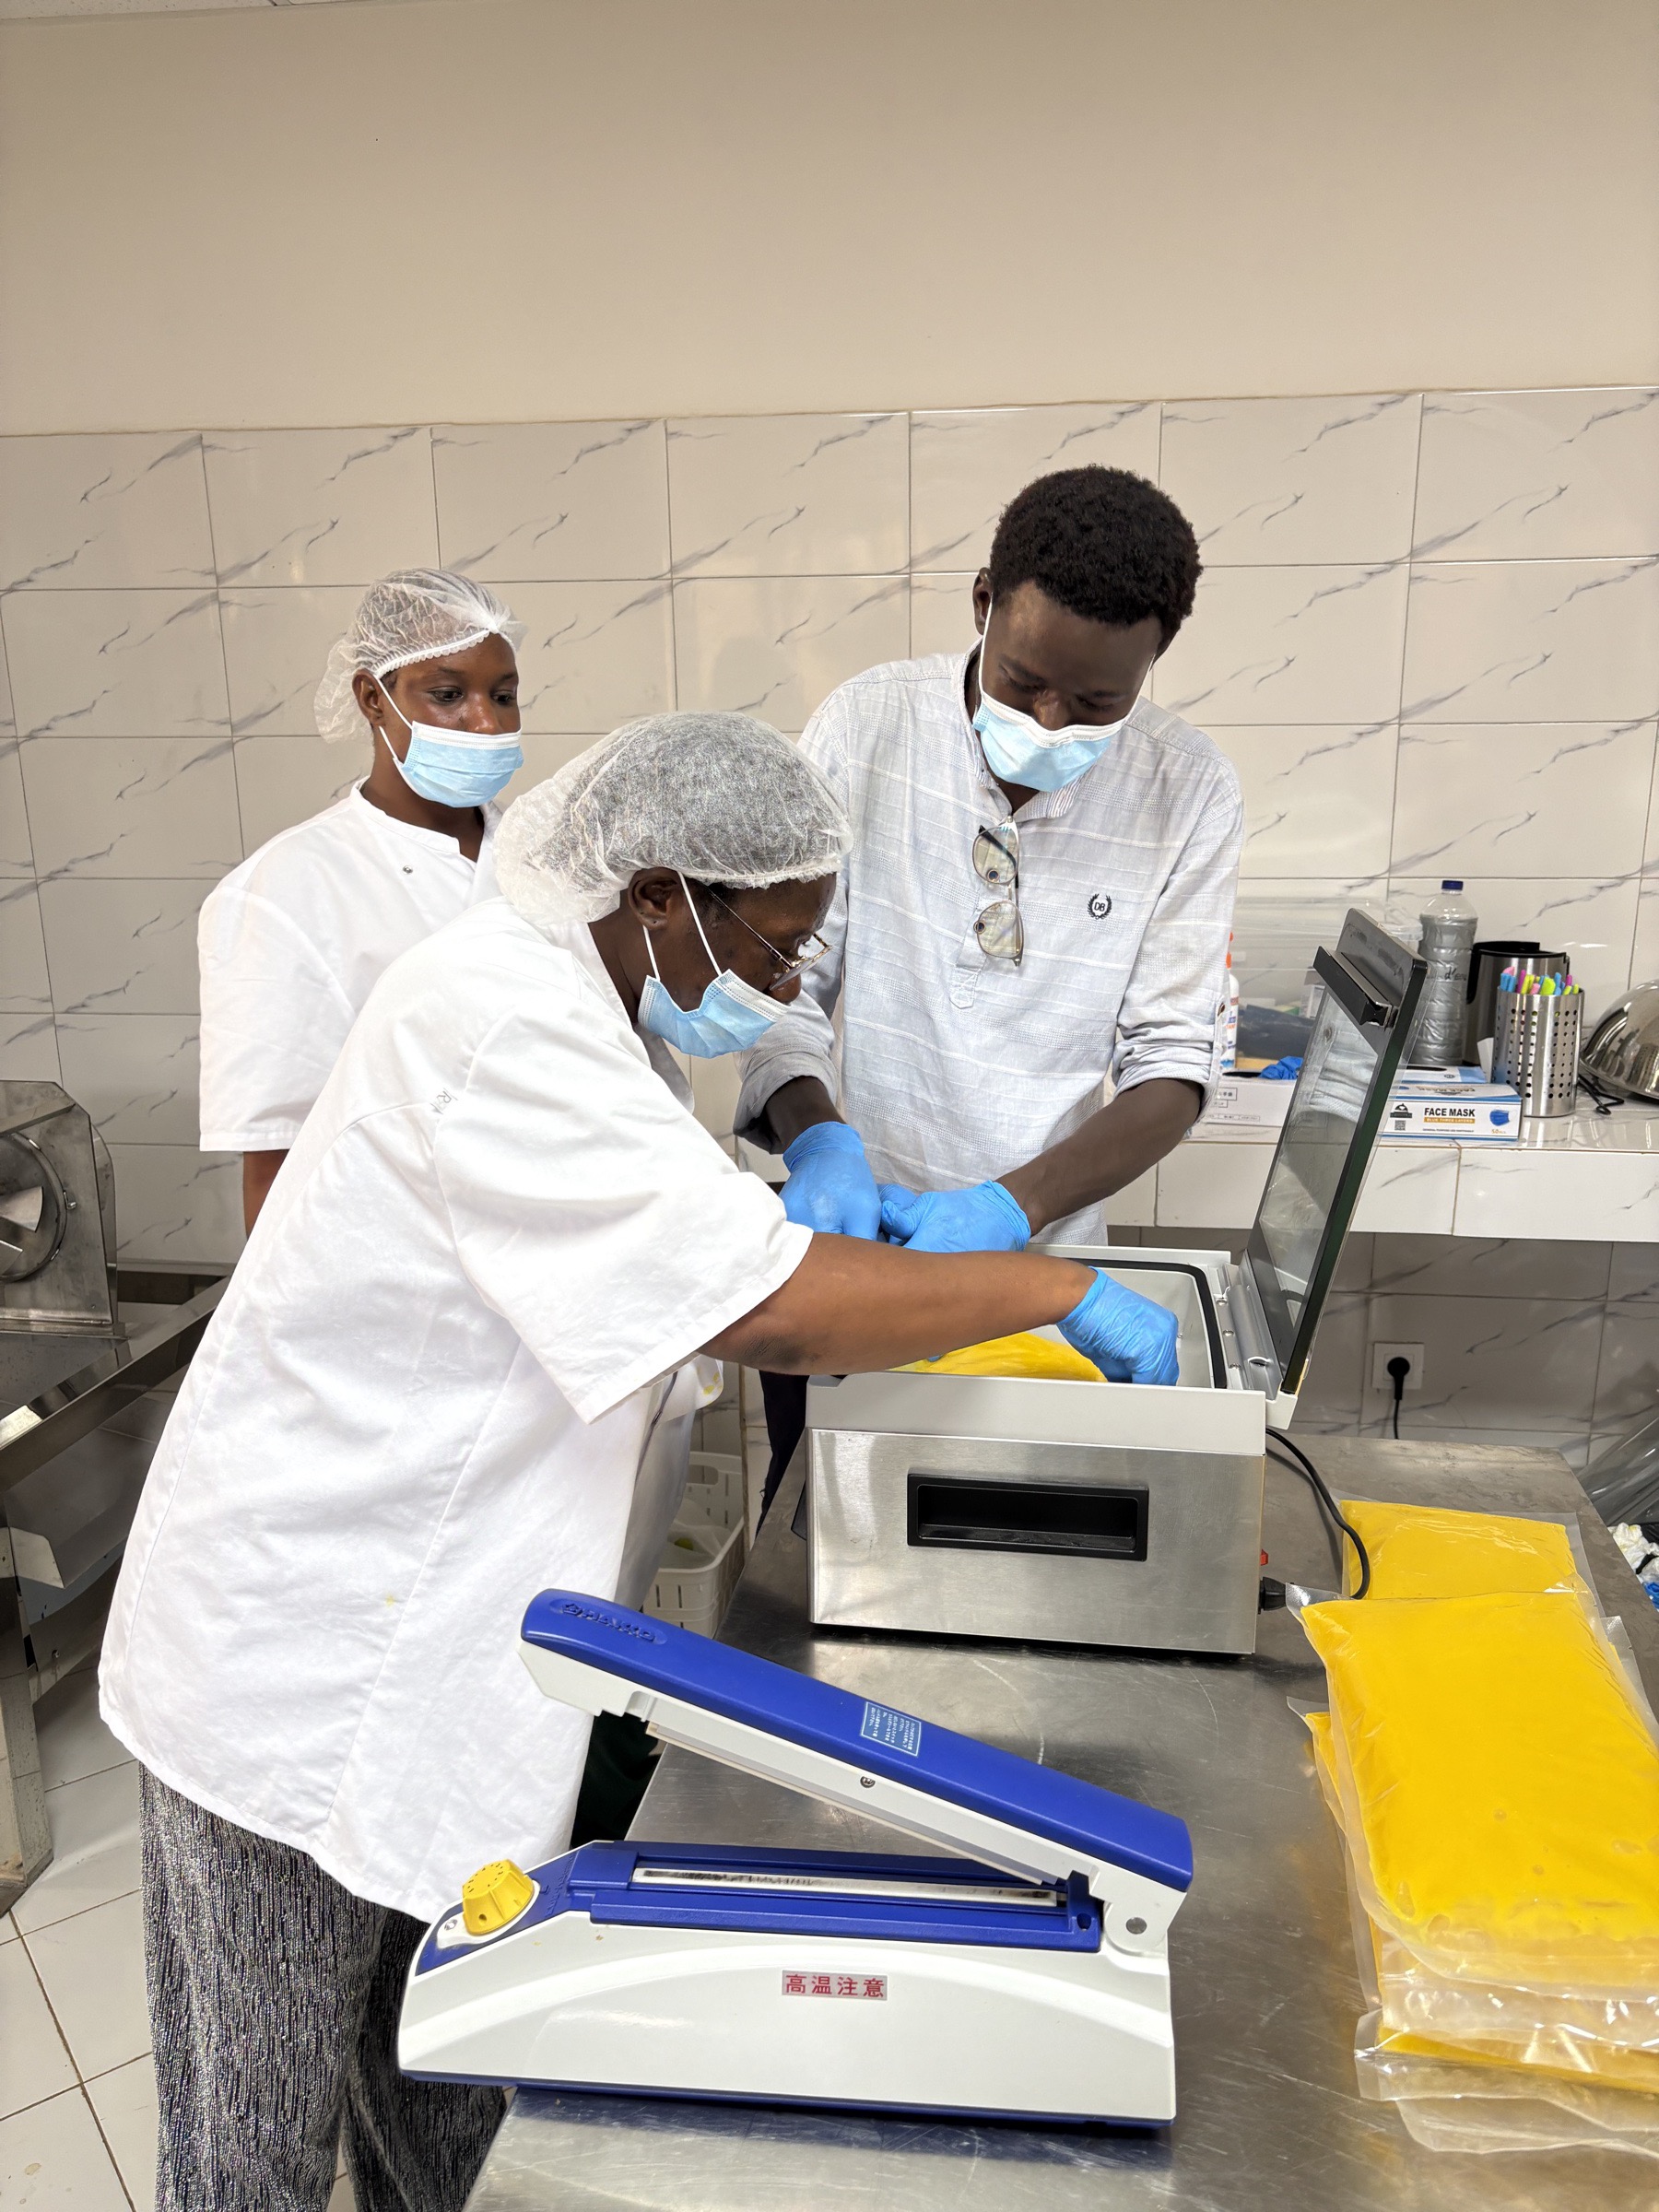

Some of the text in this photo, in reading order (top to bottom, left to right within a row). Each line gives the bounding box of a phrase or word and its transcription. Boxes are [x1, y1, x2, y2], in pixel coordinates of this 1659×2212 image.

[1424, 1107, 1476, 1117] FACE MASK
[785, 1974, 884, 1997] 高温注意
